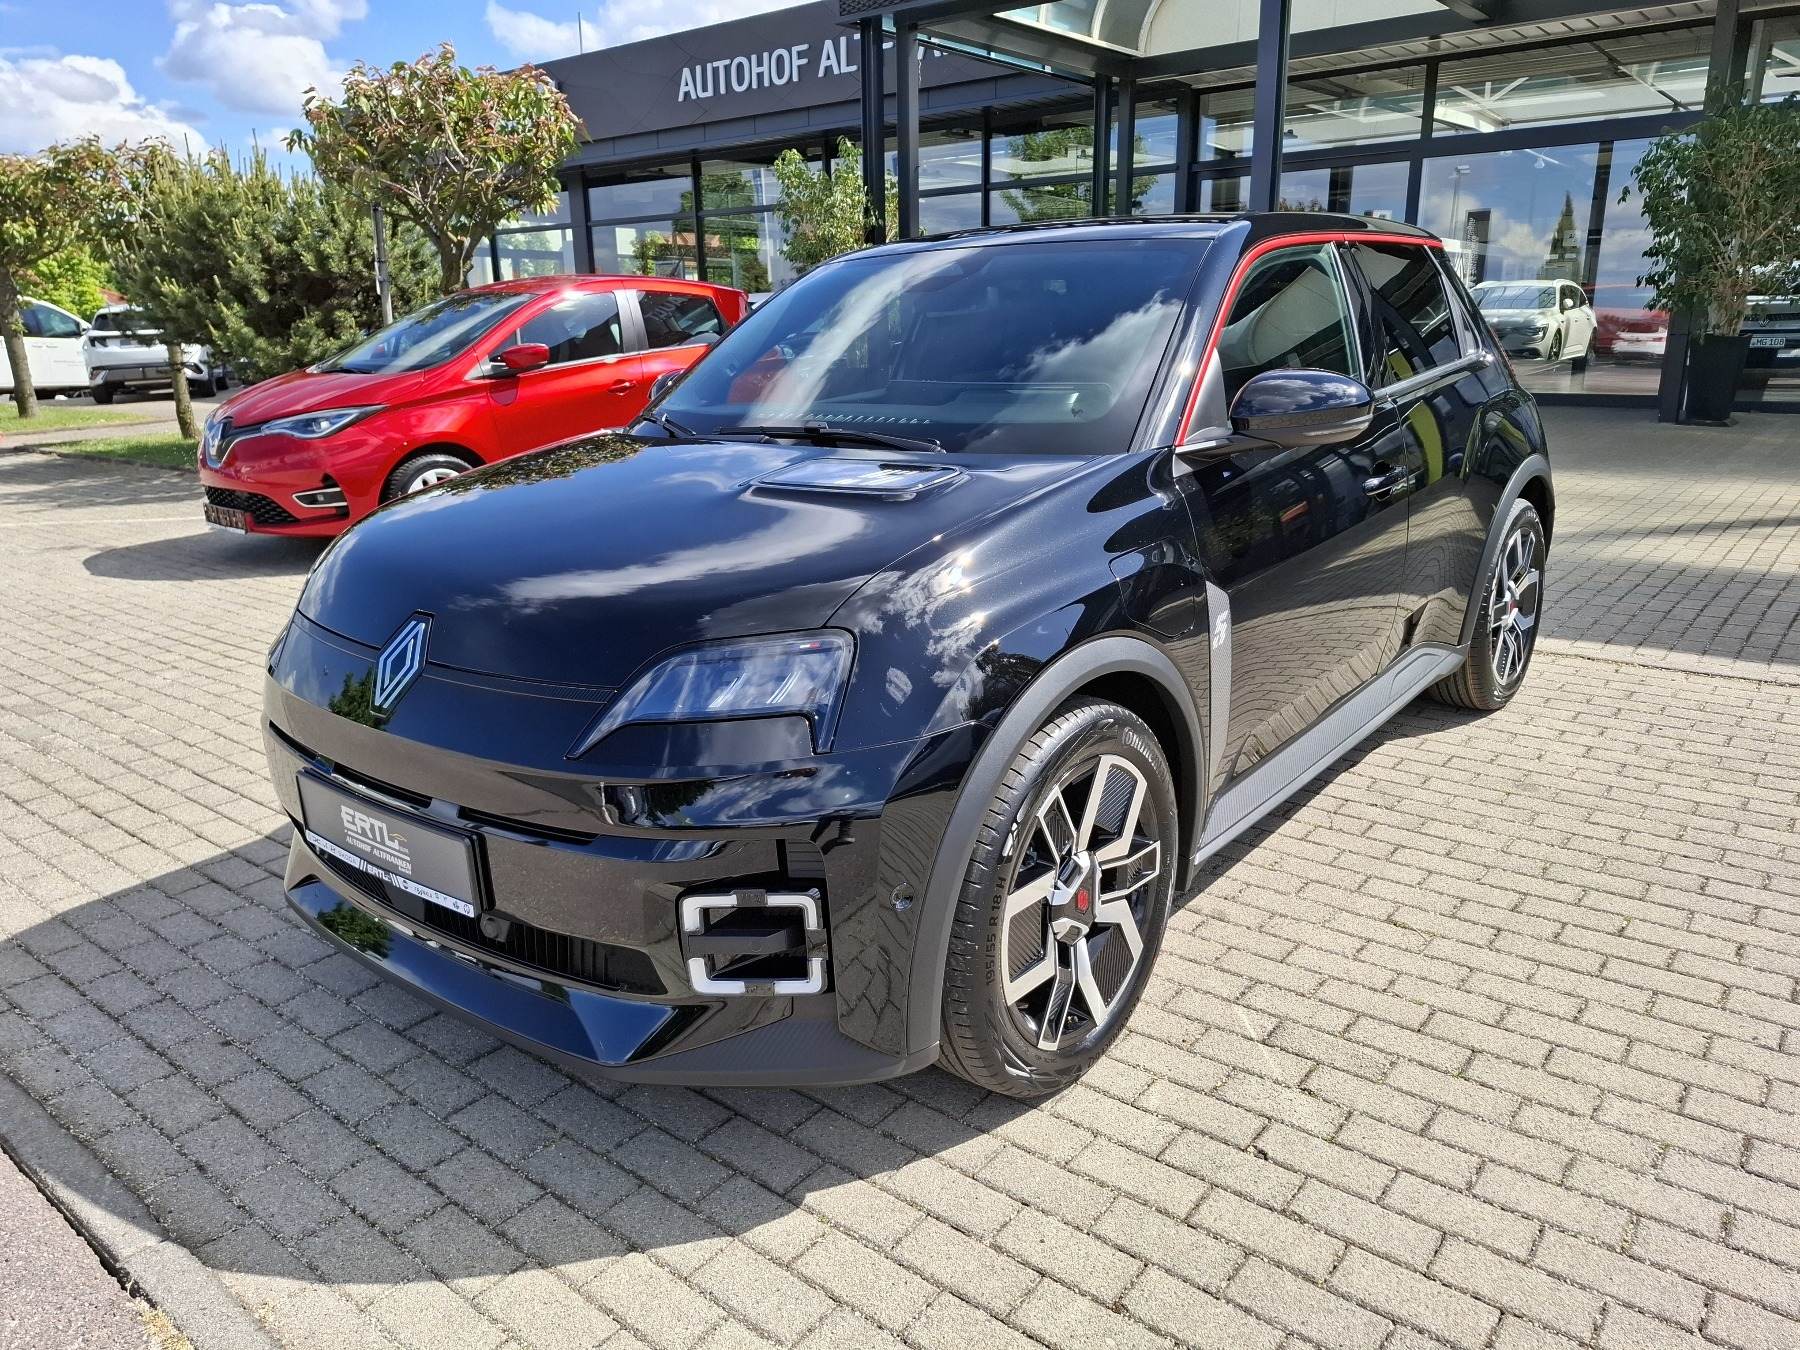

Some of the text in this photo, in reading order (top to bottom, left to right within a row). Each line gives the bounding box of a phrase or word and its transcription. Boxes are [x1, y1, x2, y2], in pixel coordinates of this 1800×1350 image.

[678, 43, 810, 102] AUTOHOF
[341, 805, 400, 849] ERTL
[988, 915, 999, 927] R
[990, 894, 1003, 912] 18
[985, 933, 997, 987] 195/55
